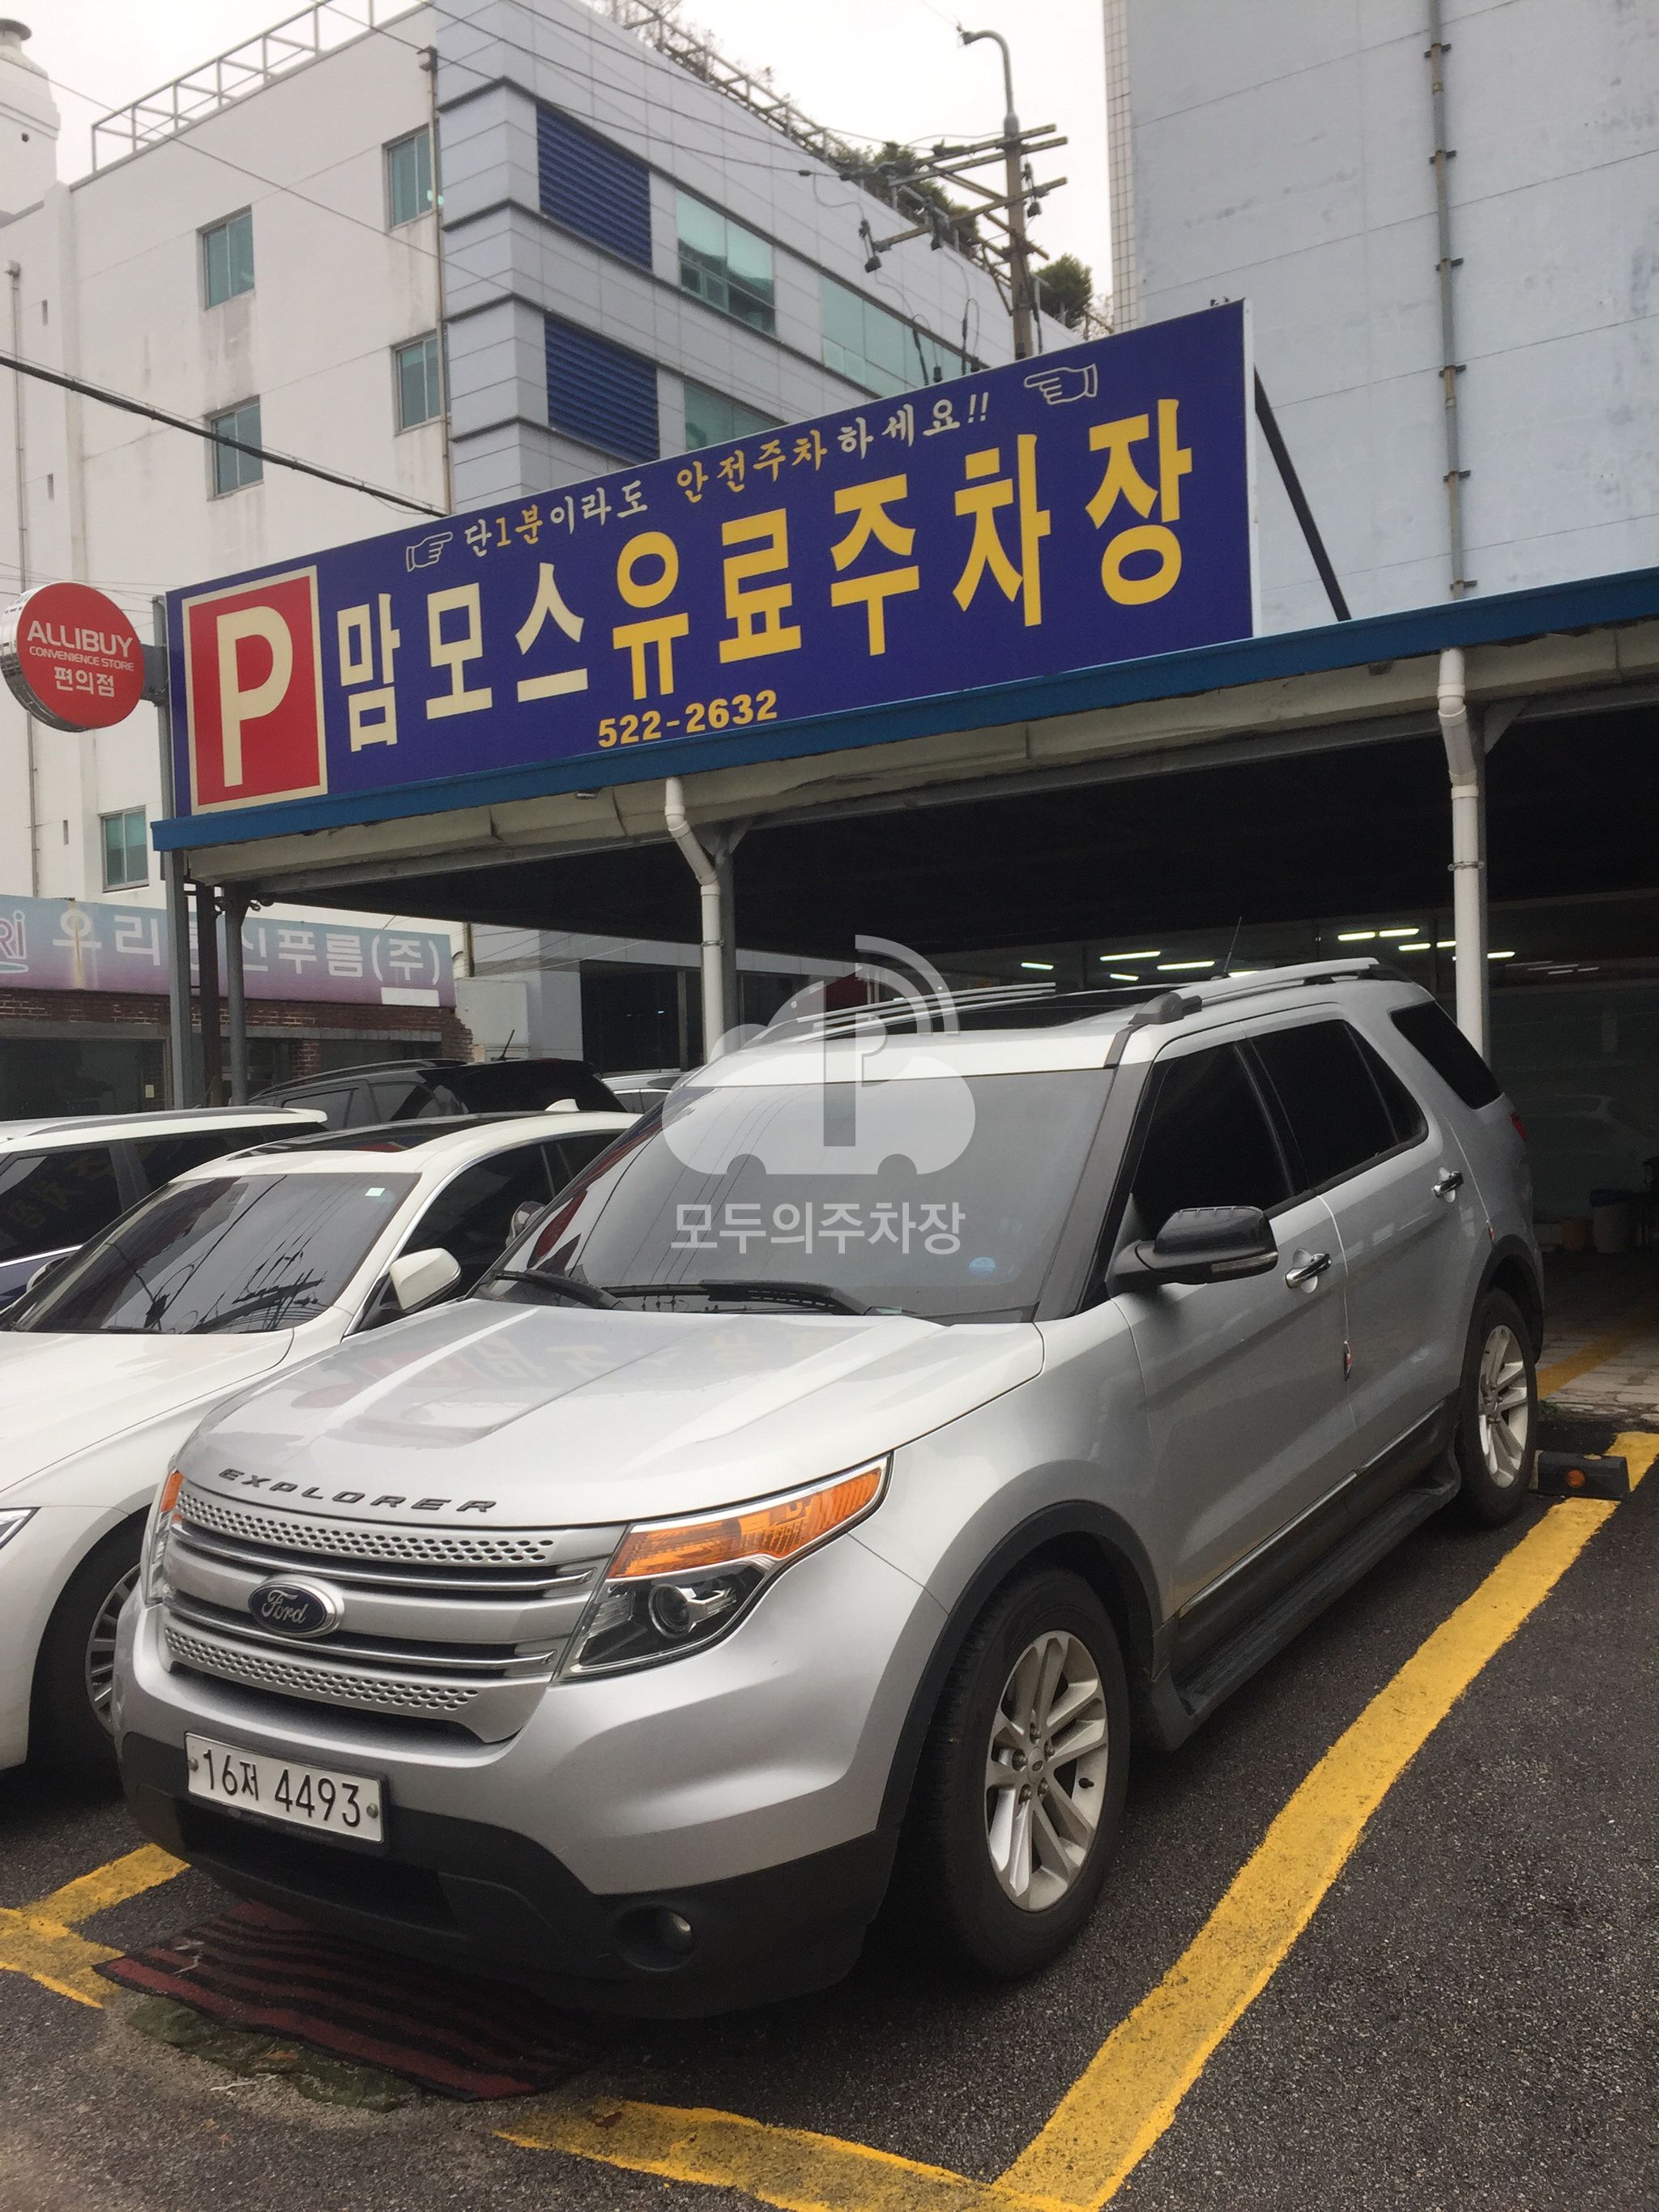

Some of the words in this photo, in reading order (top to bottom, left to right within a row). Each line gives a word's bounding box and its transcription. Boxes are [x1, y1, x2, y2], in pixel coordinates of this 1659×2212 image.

[464, 479, 649, 558] 단1분이라도
[27, 620, 133, 658] ALLIBUY
[29, 646, 100, 666] CONVENIENCE
[100, 658, 134, 671] STORE
[53, 666, 115, 697] 편의점
[216, 605, 293, 788] P
[597, 689, 778, 748] 522-2632
[218, 1468, 497, 1513] EXPLORER
[262, 1589, 309, 1624] Ford
[203, 1749, 259, 1801] 16저
[274, 1768, 360, 1827] 4493
